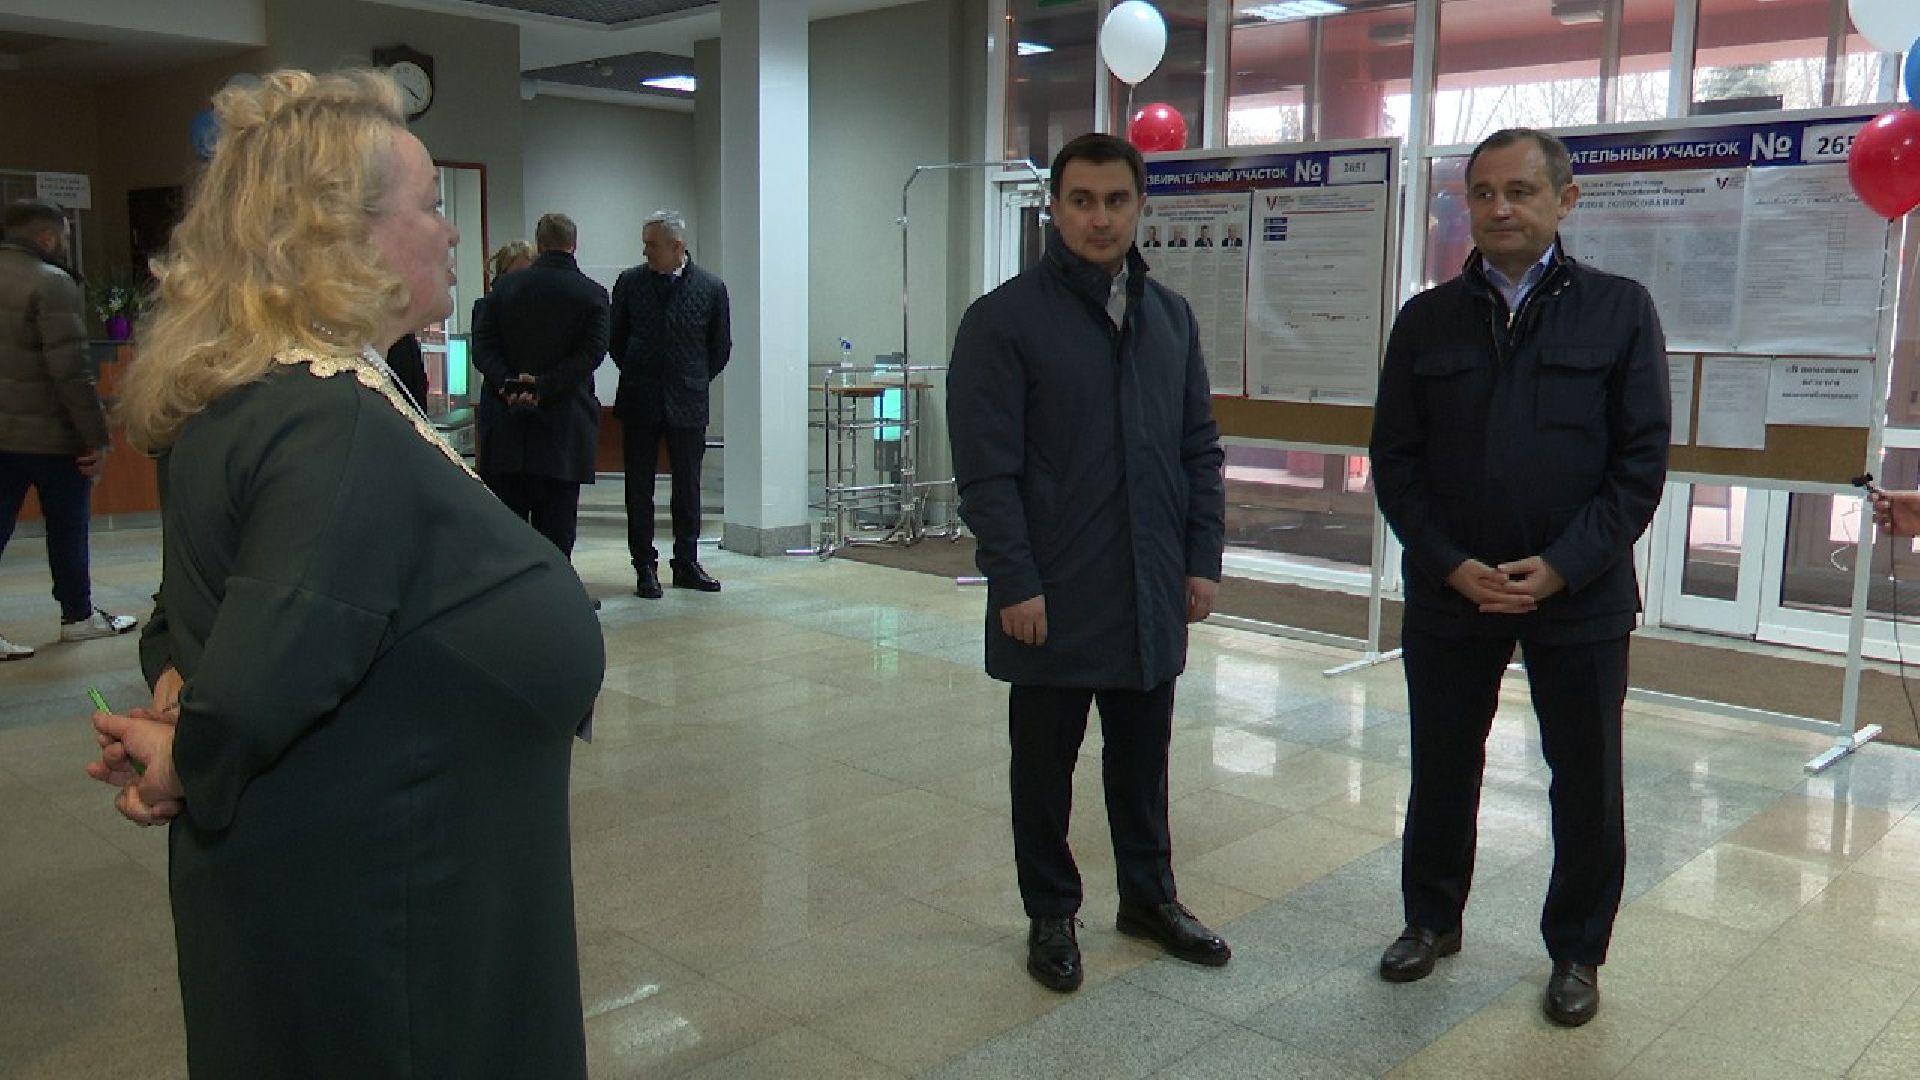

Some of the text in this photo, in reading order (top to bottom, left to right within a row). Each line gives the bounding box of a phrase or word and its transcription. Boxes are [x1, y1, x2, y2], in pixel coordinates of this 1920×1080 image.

[1568, 132, 1855, 163] АТЕЛЬНЫЙ УЧАСТОК № 265
[1146, 168, 1233, 185] ЗБИРАТЕЛЬНЫЙ
[1236, 168, 1288, 180] УЧАСТОК
[1295, 159, 1321, 183] №
